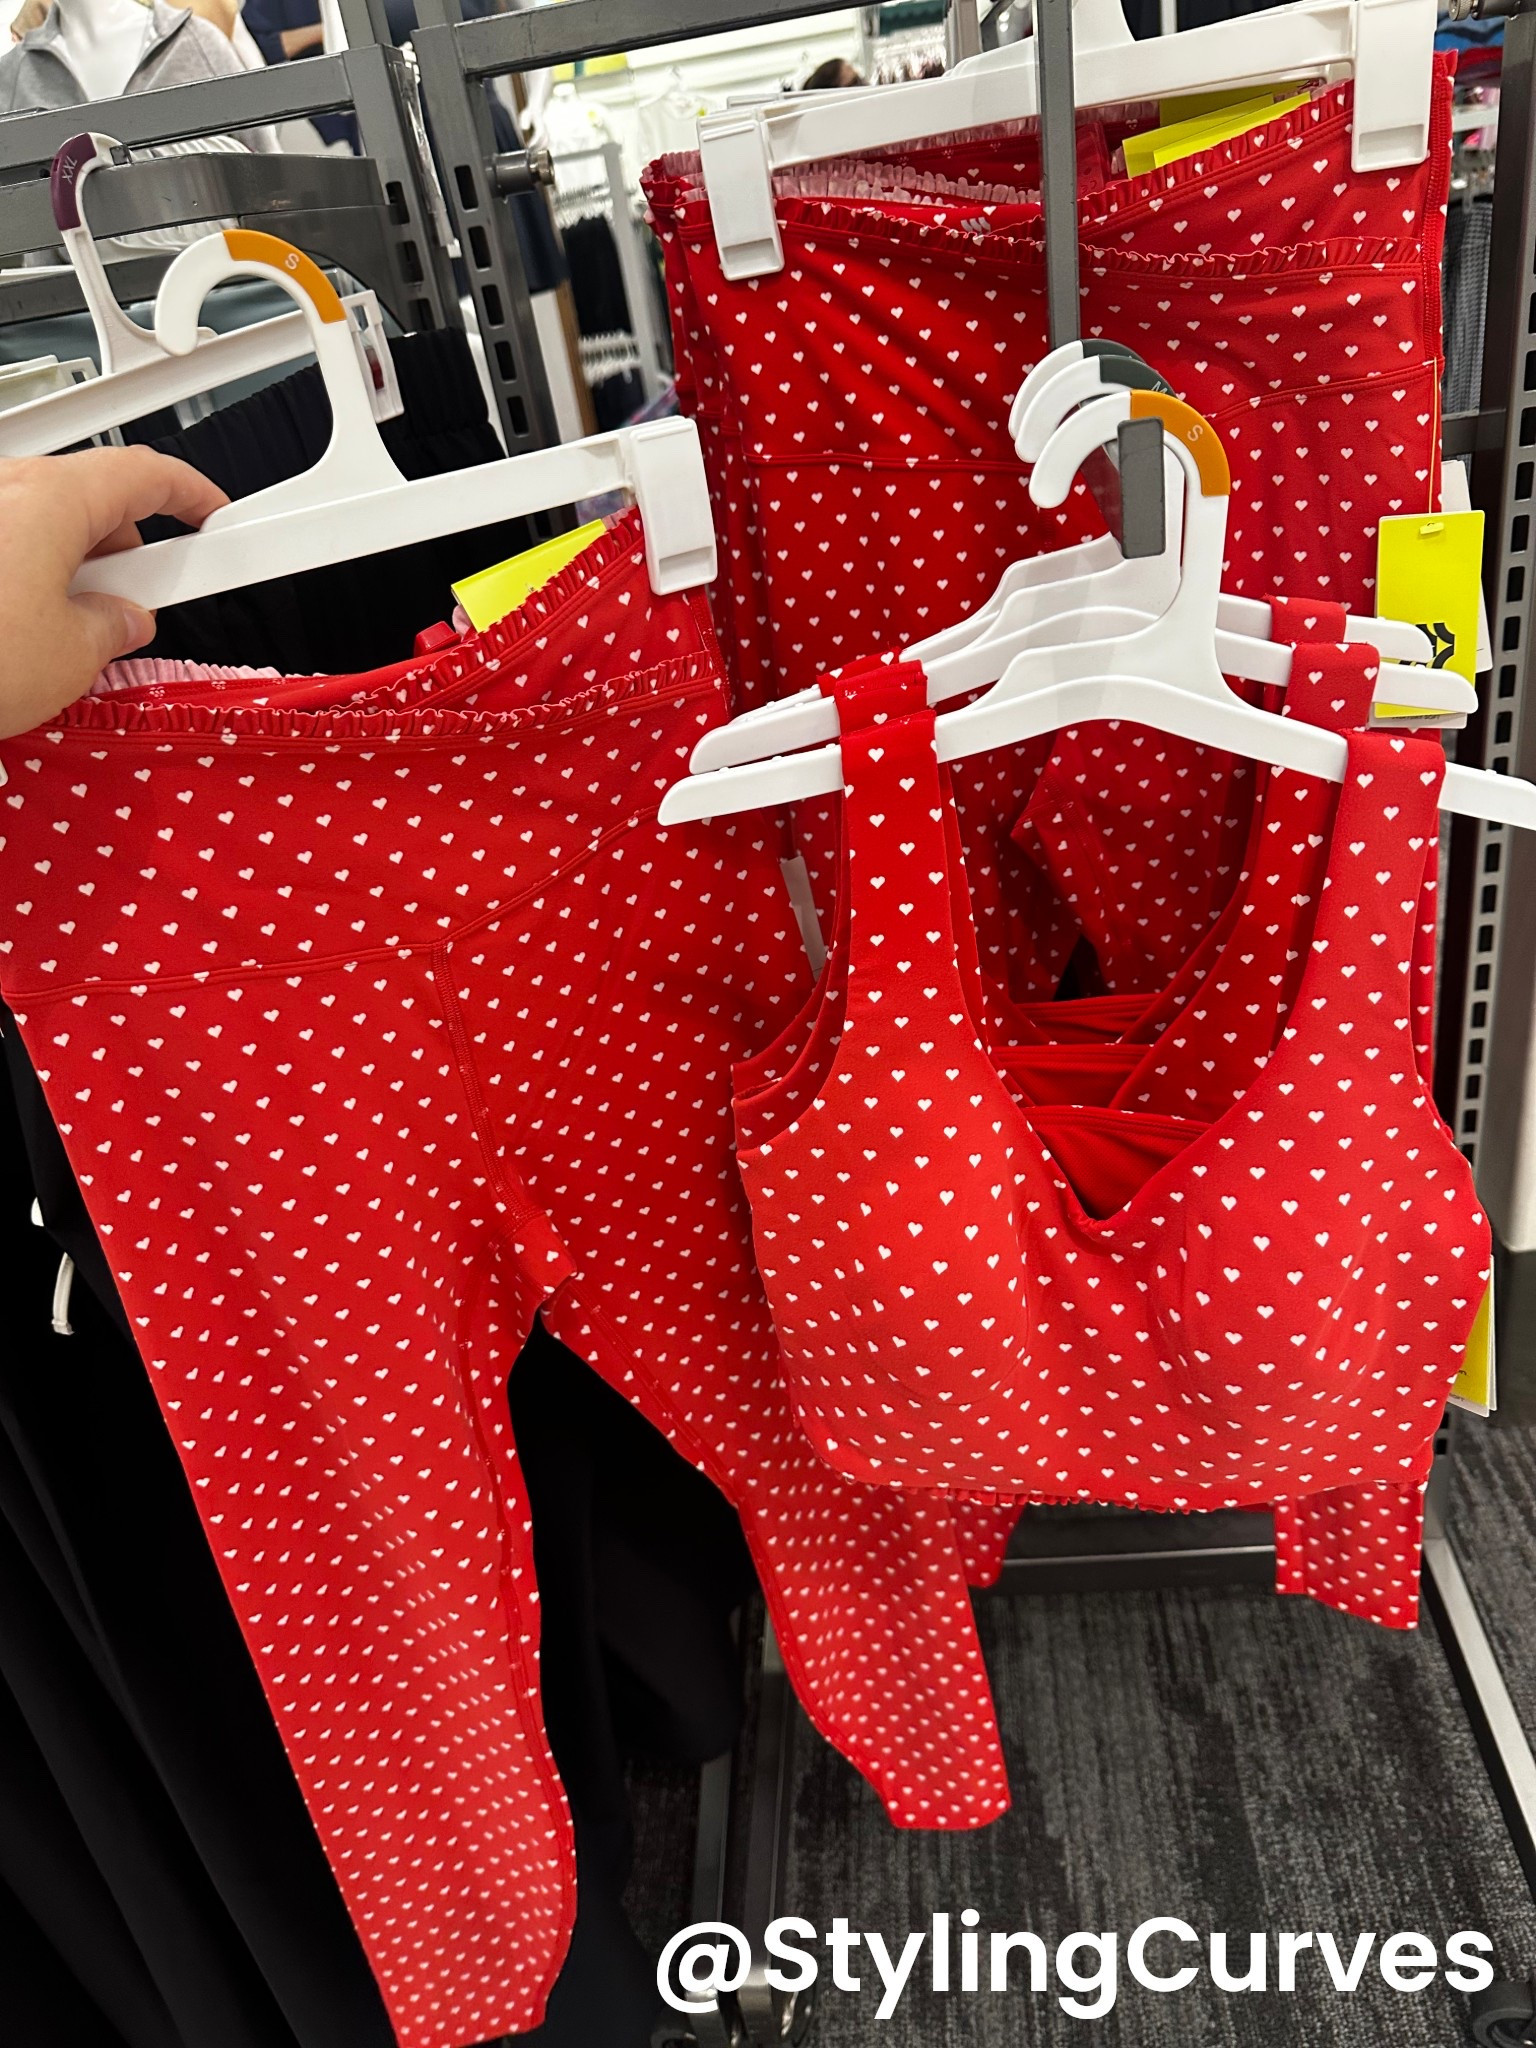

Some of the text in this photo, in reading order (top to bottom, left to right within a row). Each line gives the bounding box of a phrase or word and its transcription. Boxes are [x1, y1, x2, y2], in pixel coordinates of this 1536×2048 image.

[61, 155, 78, 185] XXL
[285, 252, 300, 270] S
[1187, 424, 1204, 441] S
